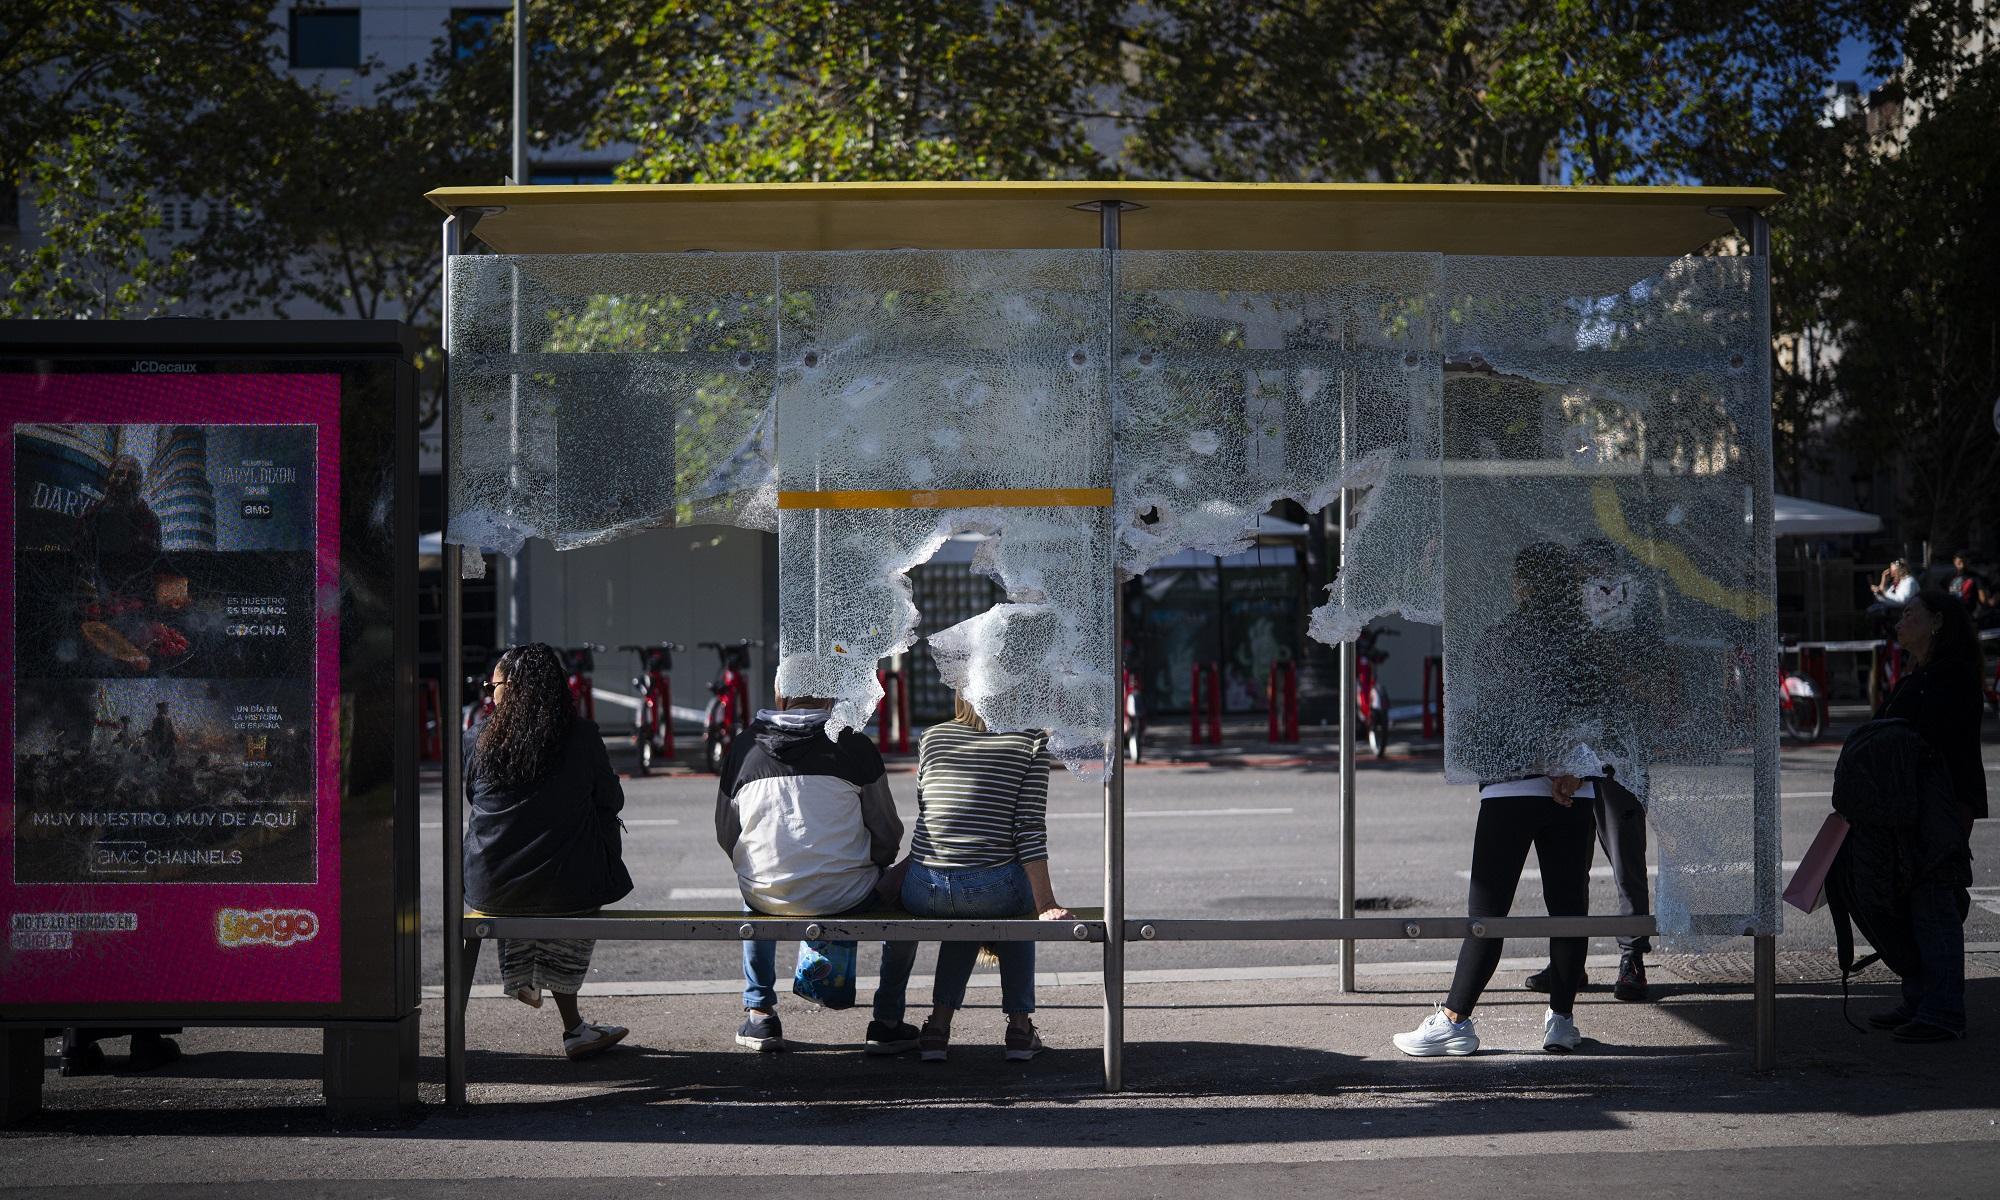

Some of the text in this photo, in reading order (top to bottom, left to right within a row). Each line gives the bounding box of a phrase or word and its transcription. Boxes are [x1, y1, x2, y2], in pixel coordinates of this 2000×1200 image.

[131, 360, 197, 373] JCDecaux
[260, 466, 297, 485] DIXON
[31, 480, 95, 518] DARY
[227, 597, 285, 605] ES NUESTRO
[241, 605, 287, 615] ESPAÑOL
[226, 624, 287, 636] COCINA
[236, 705, 249, 713] UN
[33, 809, 297, 829] MUY NUESTRO, MUY DE AQUÍ
[144, 849, 243, 865] CHANNELS
[15, 916, 133, 929] NO TE LO PIERDAS EN
